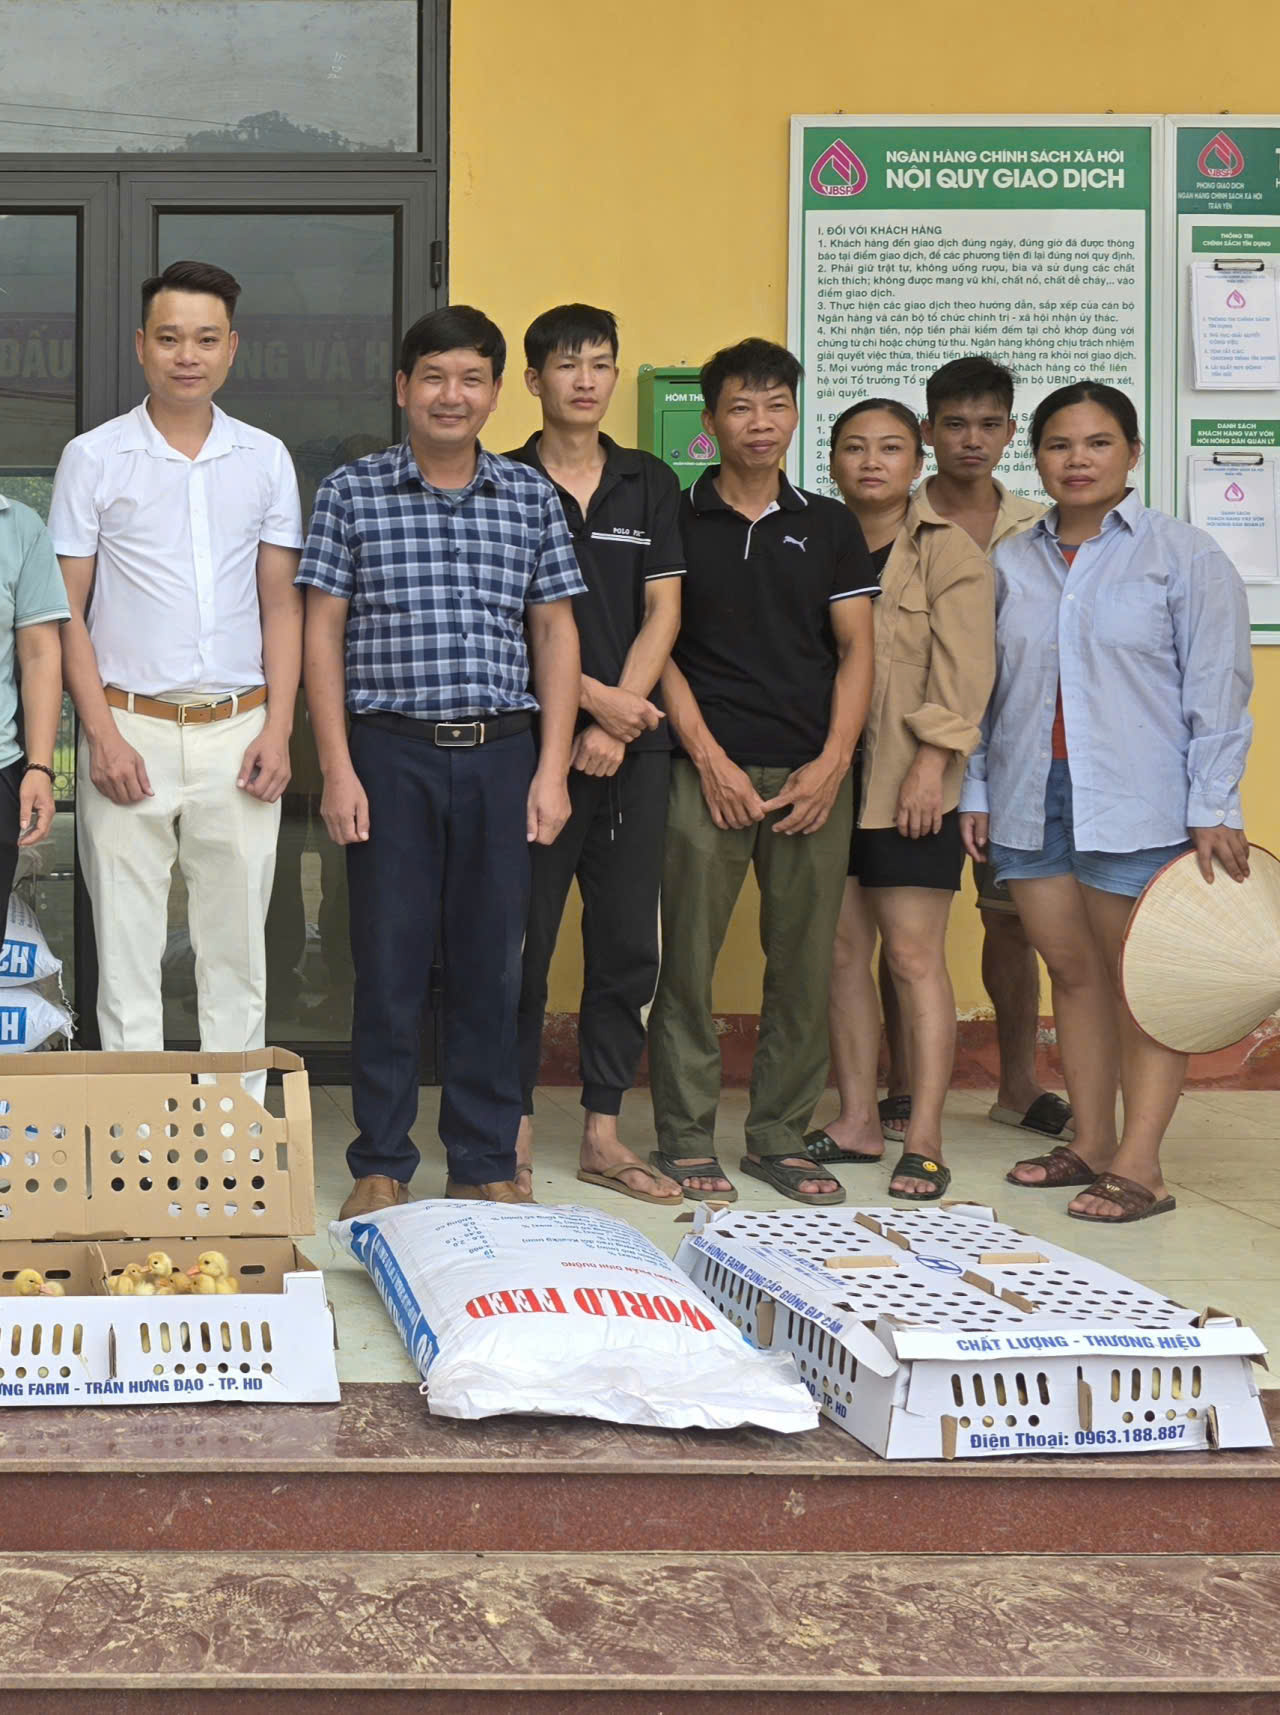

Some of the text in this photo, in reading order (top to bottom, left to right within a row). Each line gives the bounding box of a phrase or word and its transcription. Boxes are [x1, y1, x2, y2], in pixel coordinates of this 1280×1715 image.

[886, 149, 1124, 164] NGÂN HÀNG CHÍNH SÁCH XÃ HỘI
[886, 165, 1125, 191] NỘI QUY GIAO DỊCH
[818, 224, 942, 235] I. ĐỐI VỚI KHÁCH HÀNG
[818, 240, 827, 248] 1.
[817, 264, 827, 272] 2.
[613, 527, 630, 535] POLO
[693, 1236, 709, 1250] GIA
[724, 1256, 748, 1274] FARM
[744, 1268, 767, 1286] CUNG
[804, 1306, 825, 1319] GIA
[465, 1288, 716, 1332] WORLD FEED
[956, 1335, 1001, 1352] CHẤT
[1006, 1336, 1069, 1351] LƯỢNG
[1083, 1334, 1155, 1349] THƯƠNG
[1157, 1334, 1201, 1350] HIỆU
[28, 1382, 69, 1396] FARM
[129, 1379, 170, 1393] HƯNG
[174, 1378, 204, 1394] ĐẠO
[219, 1377, 239, 1390] TP.
[243, 1377, 263, 1390] HD
[835, 1401, 847, 1418] HD
[970, 1424, 1186, 1450] Điện Thoại: 0963.188.887
